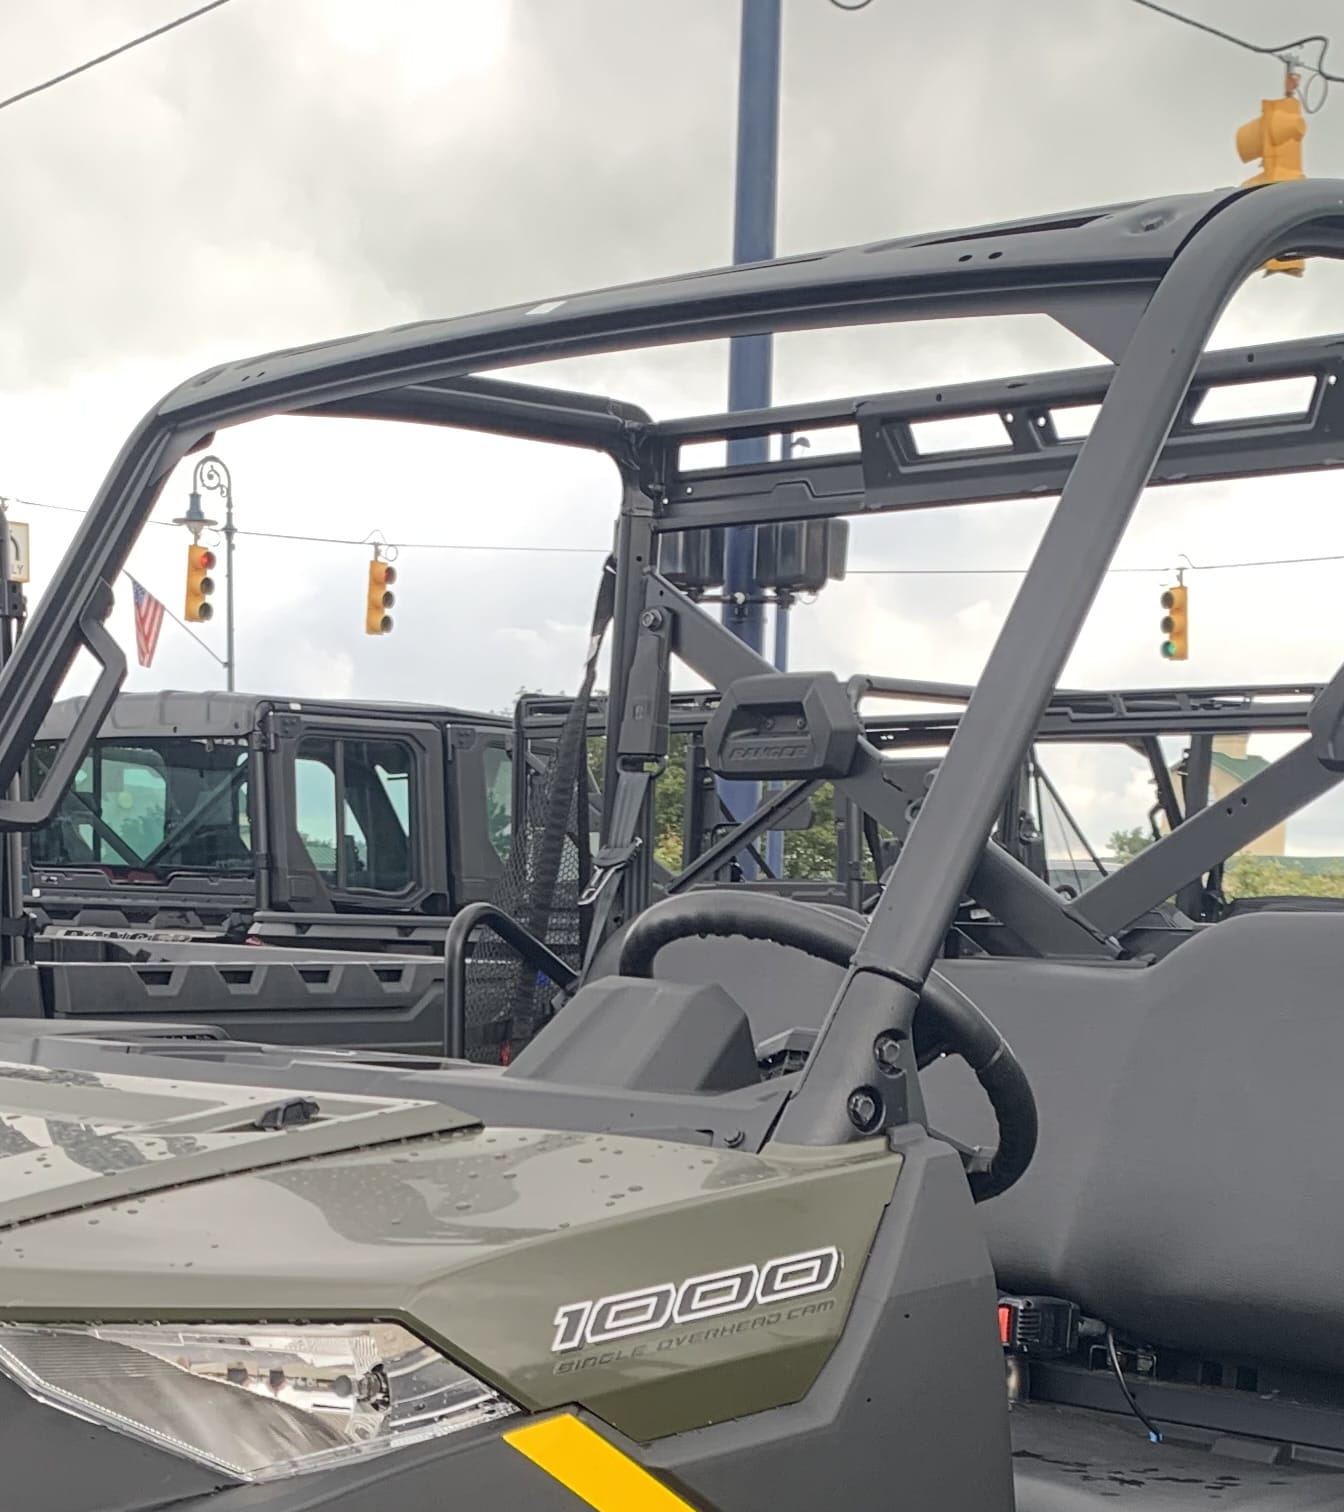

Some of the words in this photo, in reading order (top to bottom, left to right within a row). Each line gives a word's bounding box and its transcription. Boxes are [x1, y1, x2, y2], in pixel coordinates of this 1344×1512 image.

[728, 744, 809, 761] RANGER
[551, 1246, 839, 1352] 1000
[556, 1345, 647, 1375] SINGLE
[656, 1312, 781, 1352] OVERHEAD
[785, 1299, 836, 1322] CAM
